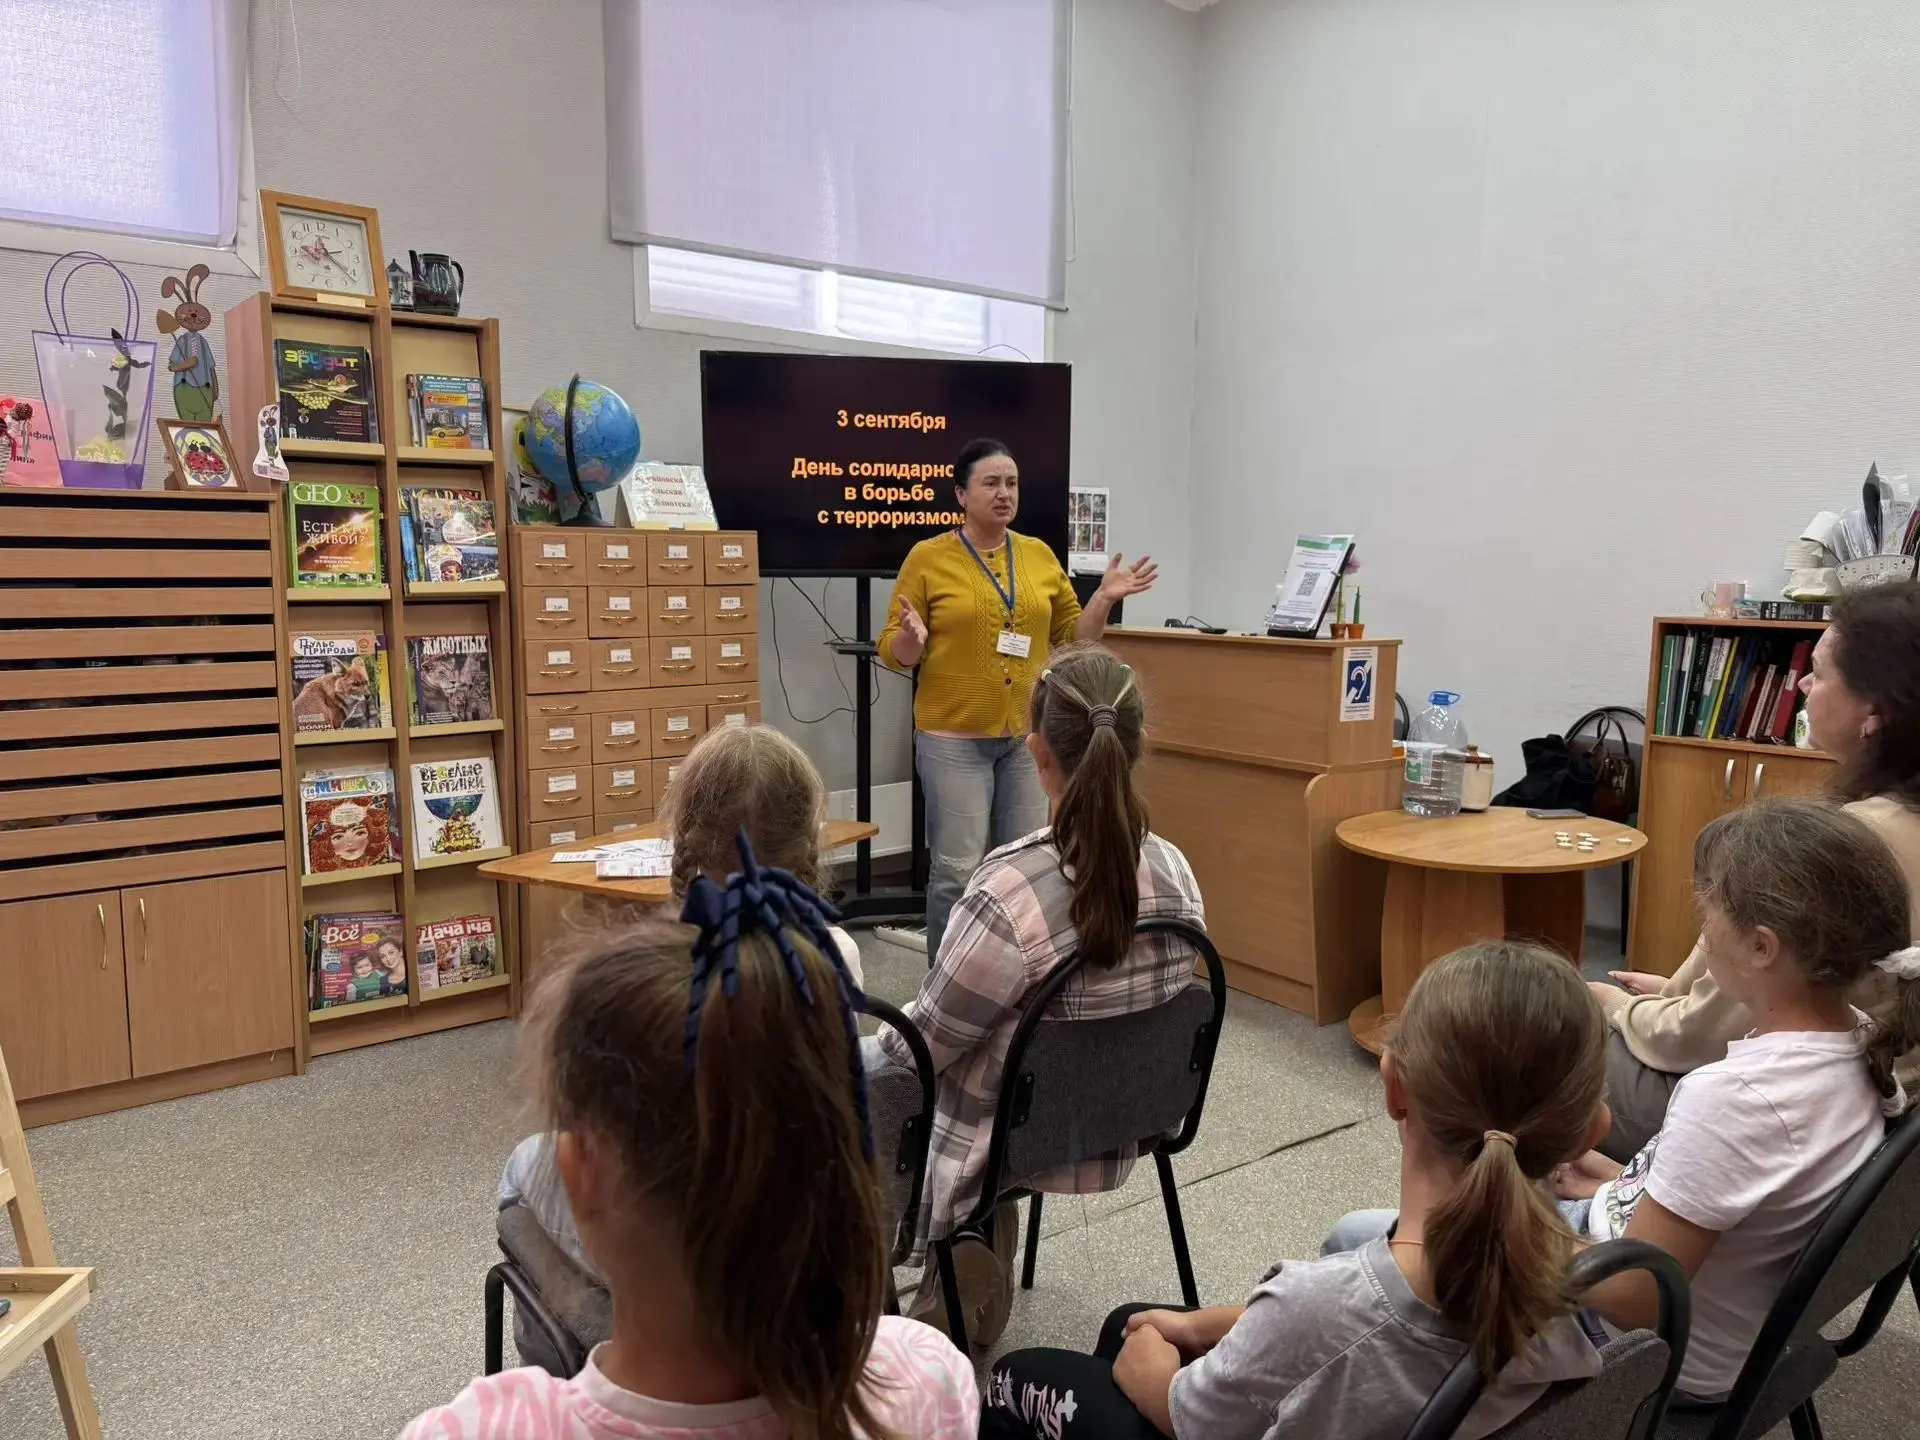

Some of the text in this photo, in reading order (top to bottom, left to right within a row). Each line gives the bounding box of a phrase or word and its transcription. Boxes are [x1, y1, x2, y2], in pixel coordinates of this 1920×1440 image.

[836, 409, 946, 433] 3 сентября
[790, 457, 954, 481] День солидарно
[293, 483, 342, 503] GEO
[844, 483, 935, 505] в борьбе
[302, 520, 338, 533] ЕСТЬ
[817, 509, 829, 524] с
[422, 635, 488, 655] ЖИВОТНЫХ
[321, 923, 360, 944] Всё
